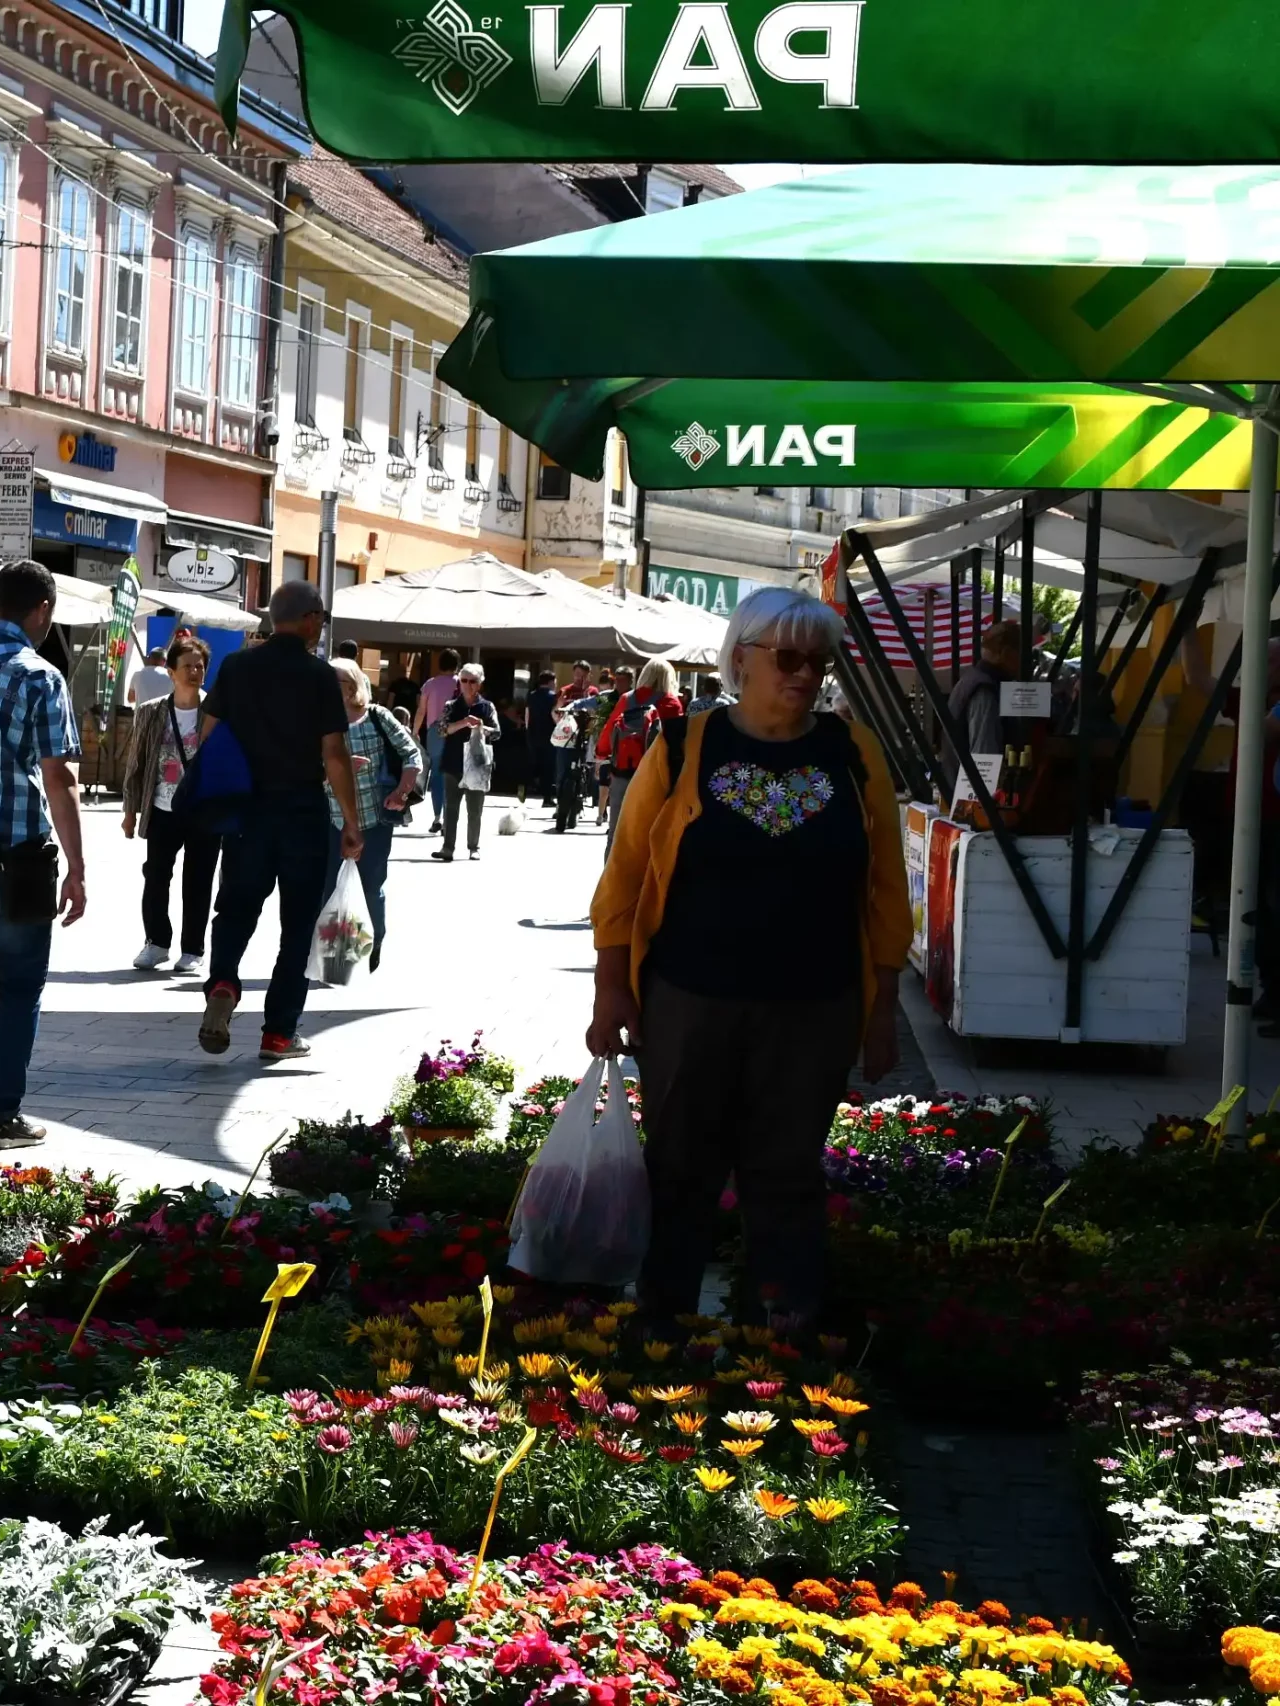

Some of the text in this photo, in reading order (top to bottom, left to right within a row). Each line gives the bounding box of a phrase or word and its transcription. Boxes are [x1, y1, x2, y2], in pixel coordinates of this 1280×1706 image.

[1, 456, 30, 465] EXPRES
[73, 509, 108, 540] mlinar
[649, 571, 730, 615] MODA
